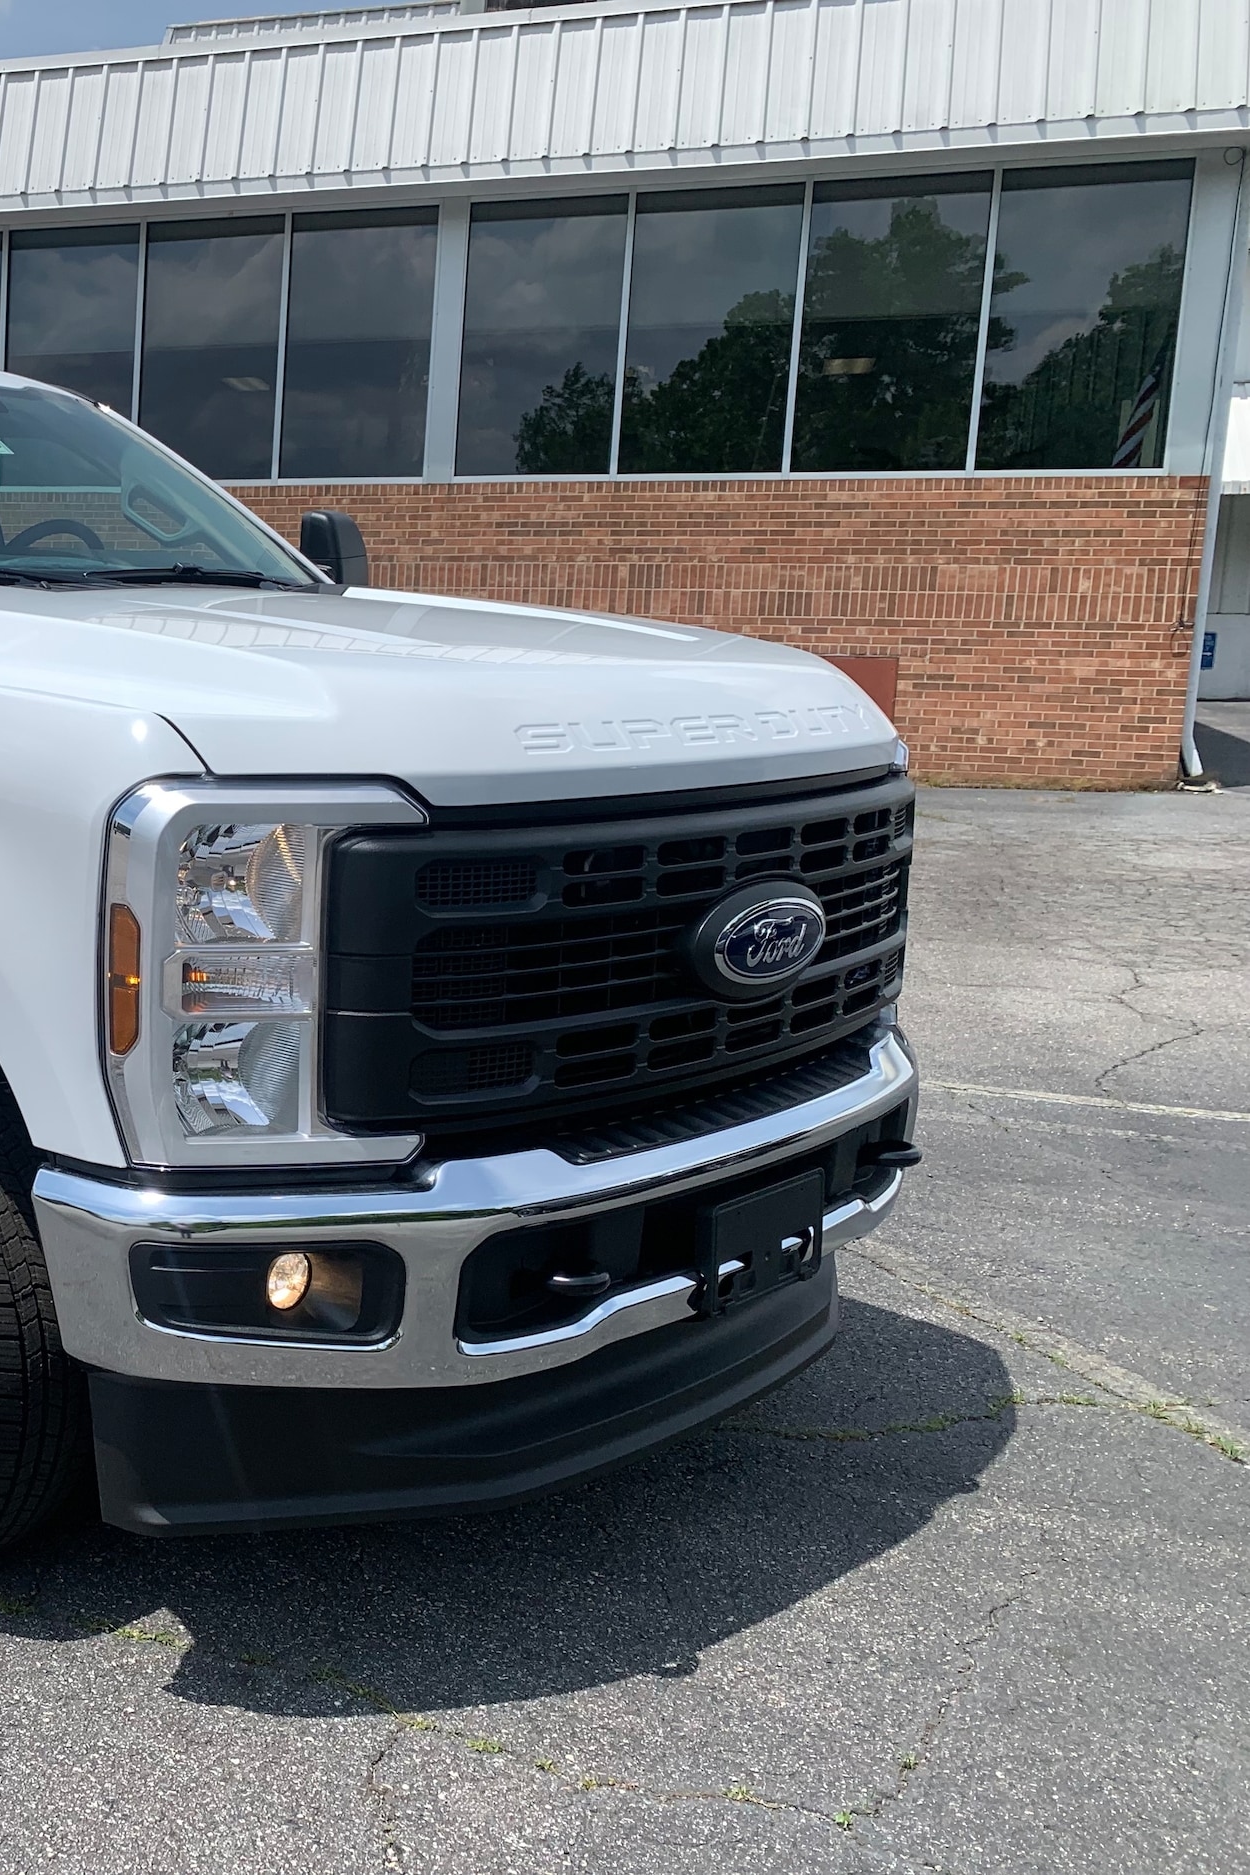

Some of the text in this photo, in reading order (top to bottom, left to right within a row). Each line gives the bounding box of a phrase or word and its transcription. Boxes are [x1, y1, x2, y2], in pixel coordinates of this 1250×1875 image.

[513, 714, 759, 756] SUPER
[754, 703, 871, 741] DUTY
[746, 916, 808, 968] Ford
